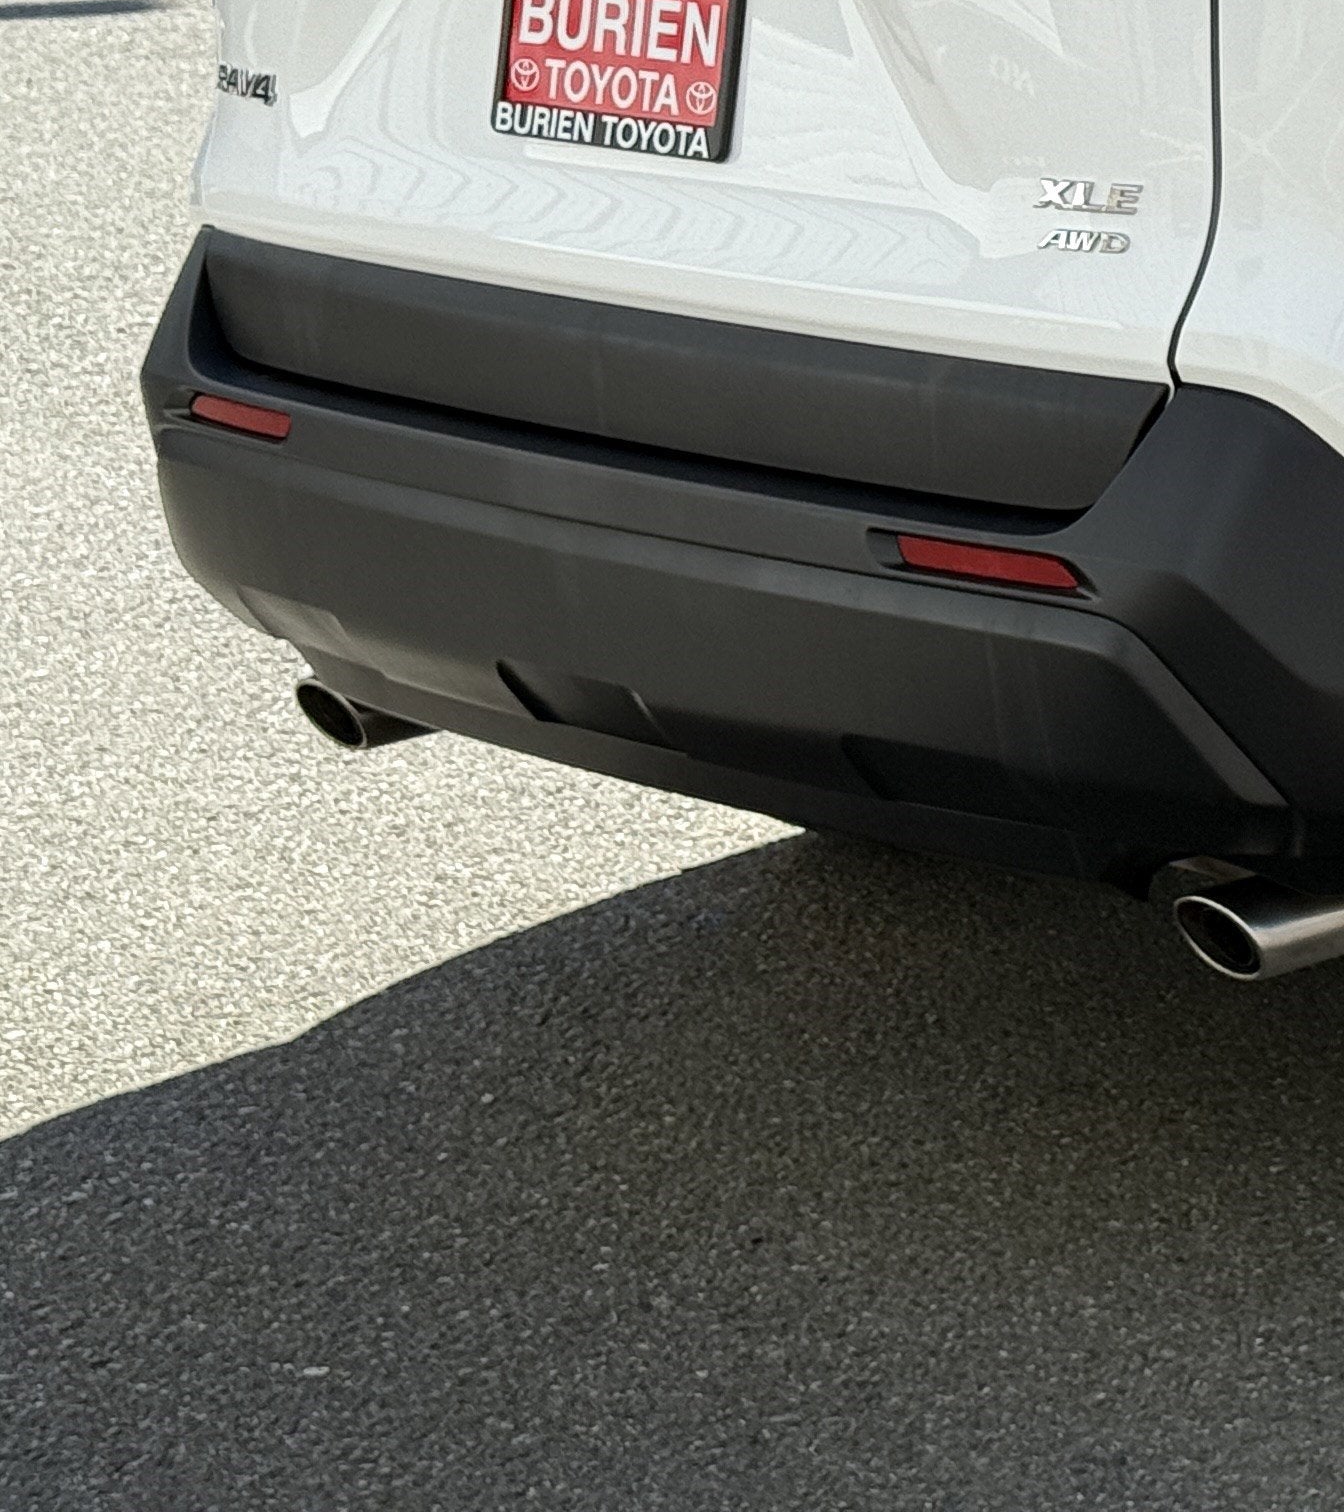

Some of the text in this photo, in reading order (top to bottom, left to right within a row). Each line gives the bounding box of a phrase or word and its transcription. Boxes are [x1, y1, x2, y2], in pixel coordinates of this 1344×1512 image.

[544, 58, 679, 116] TOYOTA
[495, 101, 710, 159] BURIEN TOYOTA
[1032, 177, 1144, 215] XLE
[1037, 228, 1131, 254] AWD
